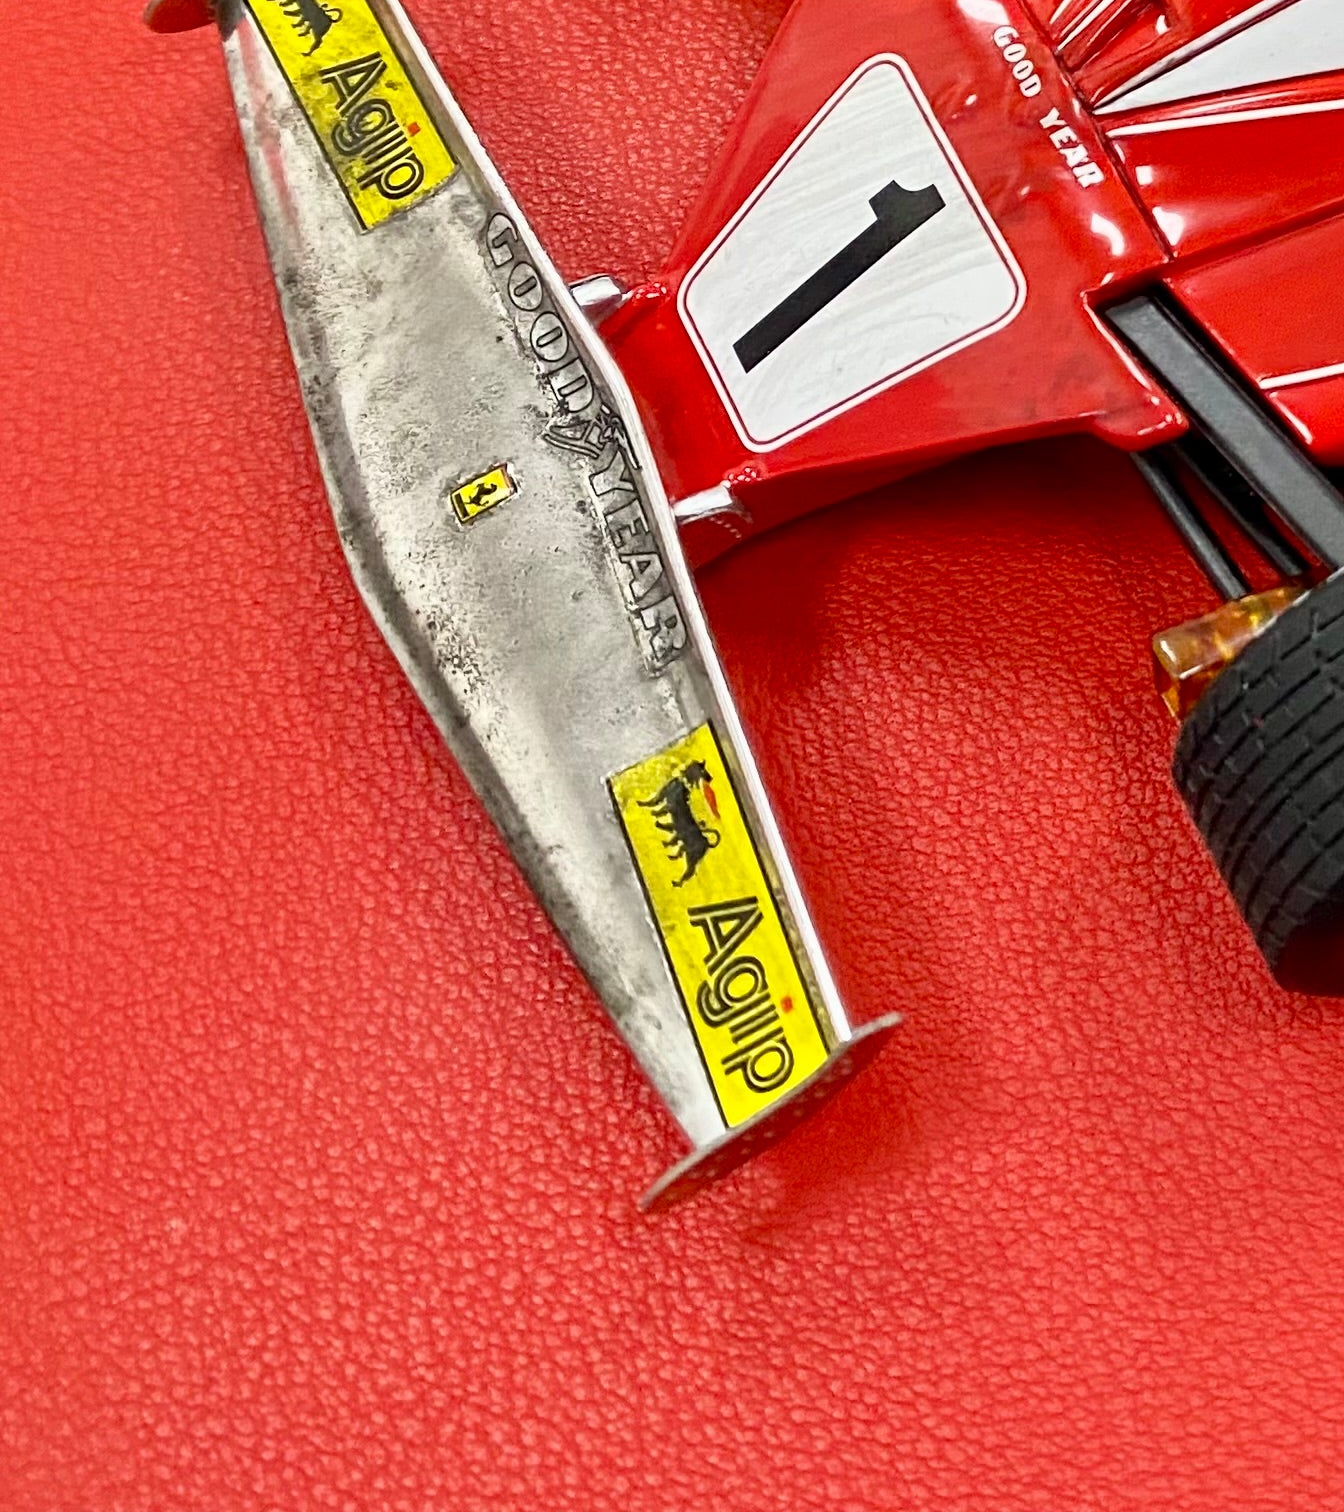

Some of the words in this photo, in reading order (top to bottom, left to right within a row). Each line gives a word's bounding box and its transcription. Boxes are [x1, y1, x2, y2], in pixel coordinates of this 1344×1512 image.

[320, 51, 427, 202] Agip
[992, 25, 1043, 99] GOOD
[1039, 107, 1105, 189] YEAR
[732, 179, 947, 375] 1
[686, 895, 796, 1094] Agip
